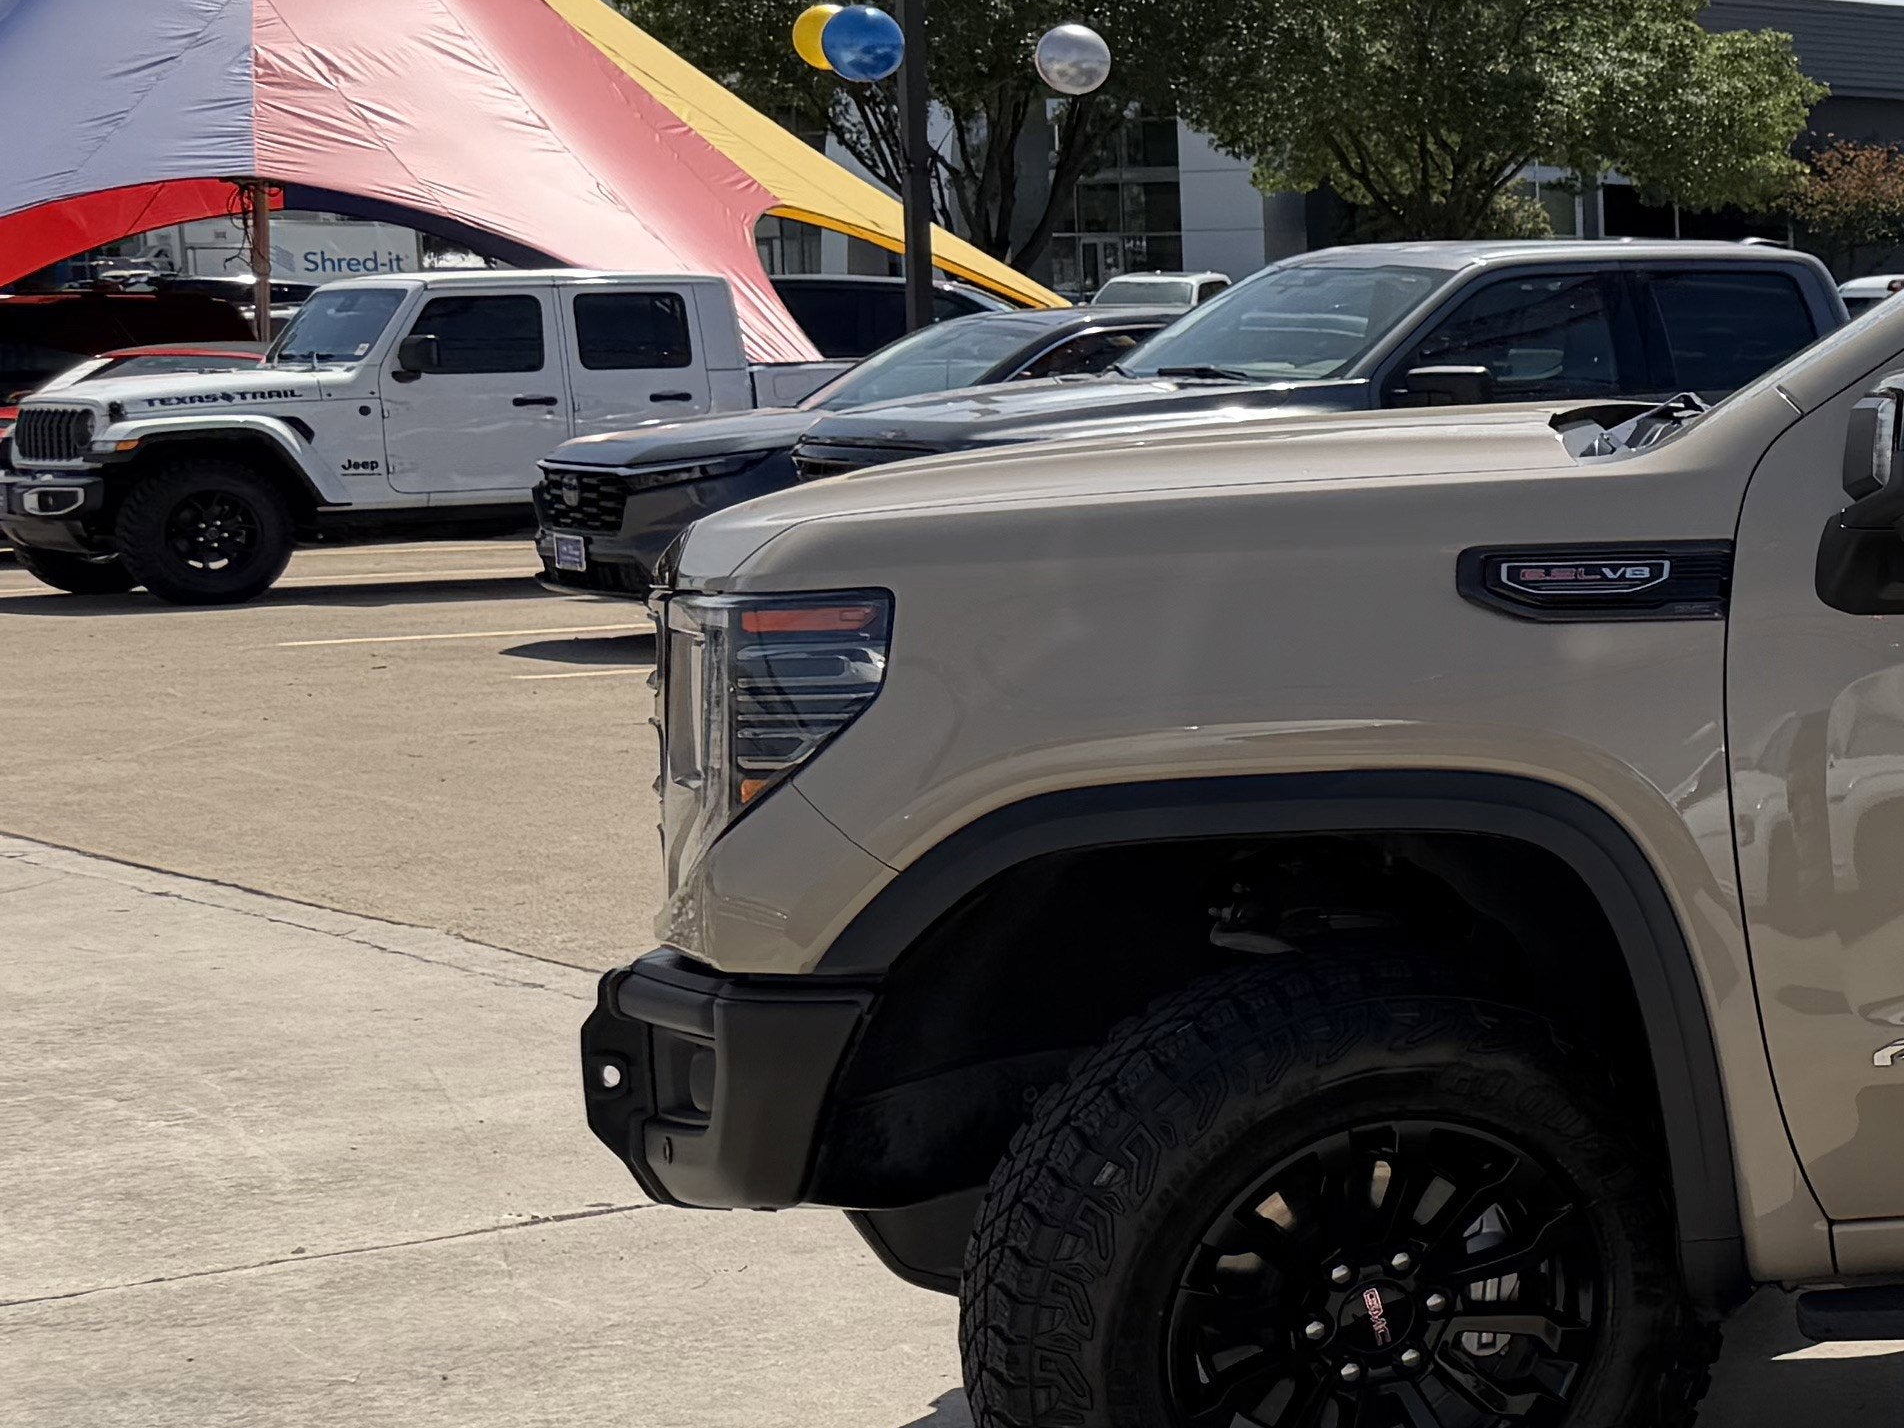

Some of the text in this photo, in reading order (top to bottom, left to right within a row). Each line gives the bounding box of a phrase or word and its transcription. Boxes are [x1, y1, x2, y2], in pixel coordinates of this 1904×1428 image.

[303, 250, 405, 273] Shred-it
[143, 388, 304, 408] TEXAS TRAIL
[341, 458, 379, 471] Jeep
[1363, 1287, 1392, 1347] GMC
